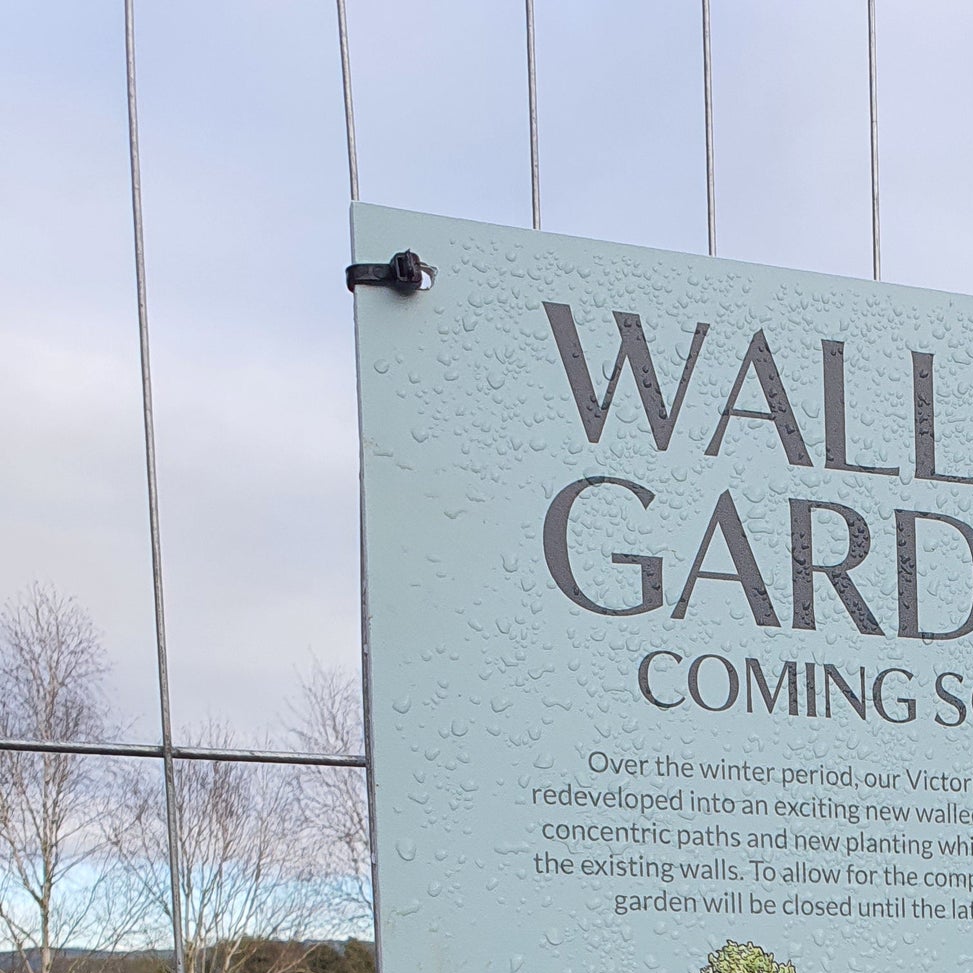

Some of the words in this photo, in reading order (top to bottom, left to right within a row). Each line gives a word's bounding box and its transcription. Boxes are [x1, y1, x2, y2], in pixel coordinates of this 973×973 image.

[638, 650, 917, 725] COMING
[588, 751, 648, 776] Over
[655, 755, 694, 778] the
[699, 759, 775, 783] winter
[782, 765, 860, 788] period,
[864, 772, 900, 789] our
[532, 784, 683, 814] redeveloped
[690, 791, 736, 814] into
[742, 798, 768, 816] an
[774, 797, 860, 824] exciting
[866, 804, 911, 823] new
[542, 823, 671, 845] concentric
[677, 825, 740, 849] paths
[747, 828, 787, 850] and
[794, 833, 841, 851] new
[846, 831, 934, 859] planting
[533, 852, 574, 876] the
[580, 855, 674, 882] existing
[680, 858, 744, 881] walls.
[749, 860, 776, 882] To
[782, 861, 841, 885] allow
[846, 864, 878, 885] for
[884, 865, 918, 887] the
[614, 890, 697, 915] garden
[703, 892, 743, 914] will
[750, 893, 776, 915] be
[782, 894, 852, 917] closed
[858, 898, 905, 919] until
[911, 899, 946, 920] the
